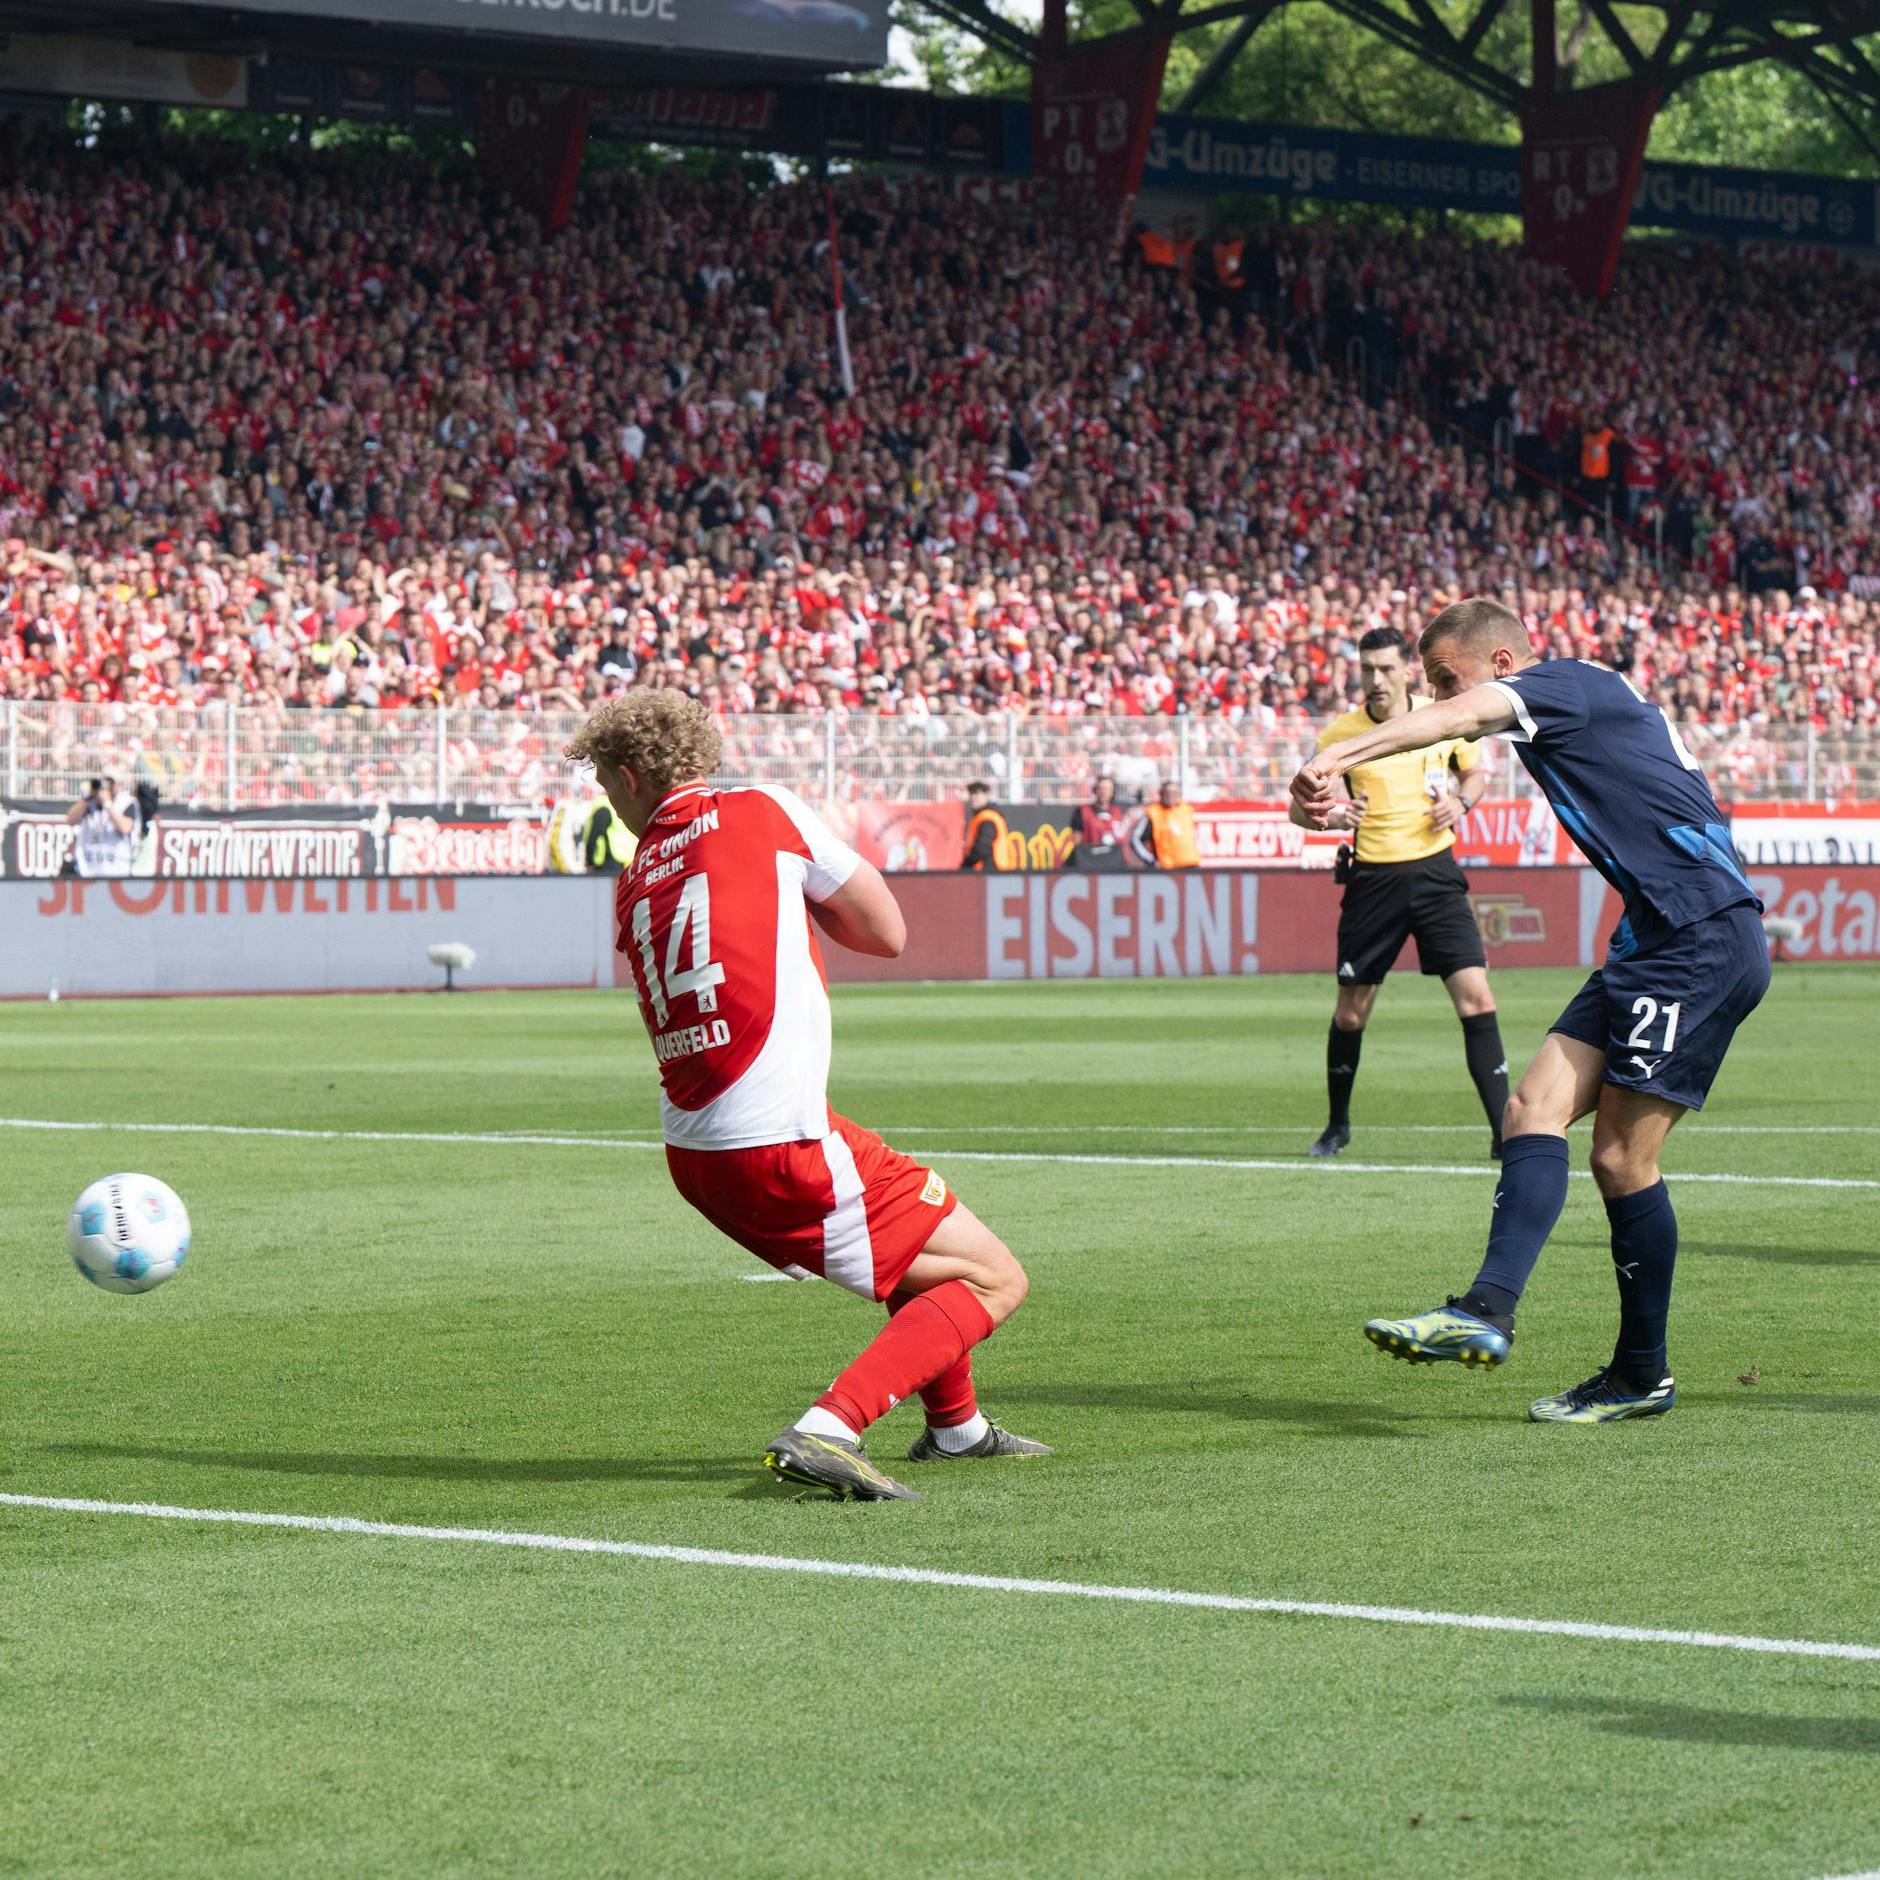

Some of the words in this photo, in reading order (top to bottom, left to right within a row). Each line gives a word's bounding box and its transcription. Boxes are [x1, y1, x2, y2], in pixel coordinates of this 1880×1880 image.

[1147, 128, 1338, 190] G-Umzüge
[1476, 169, 1521, 199] SPO
[637, 843, 657, 874] FC
[659, 809, 720, 857] UNION
[644, 855, 685, 887] BERLIN
[632, 872, 726, 1029] 14
[986, 873, 1259, 979] EISERN!
[655, 1019, 731, 1063] QUERFELD
[1628, 996, 1680, 1052] 21
